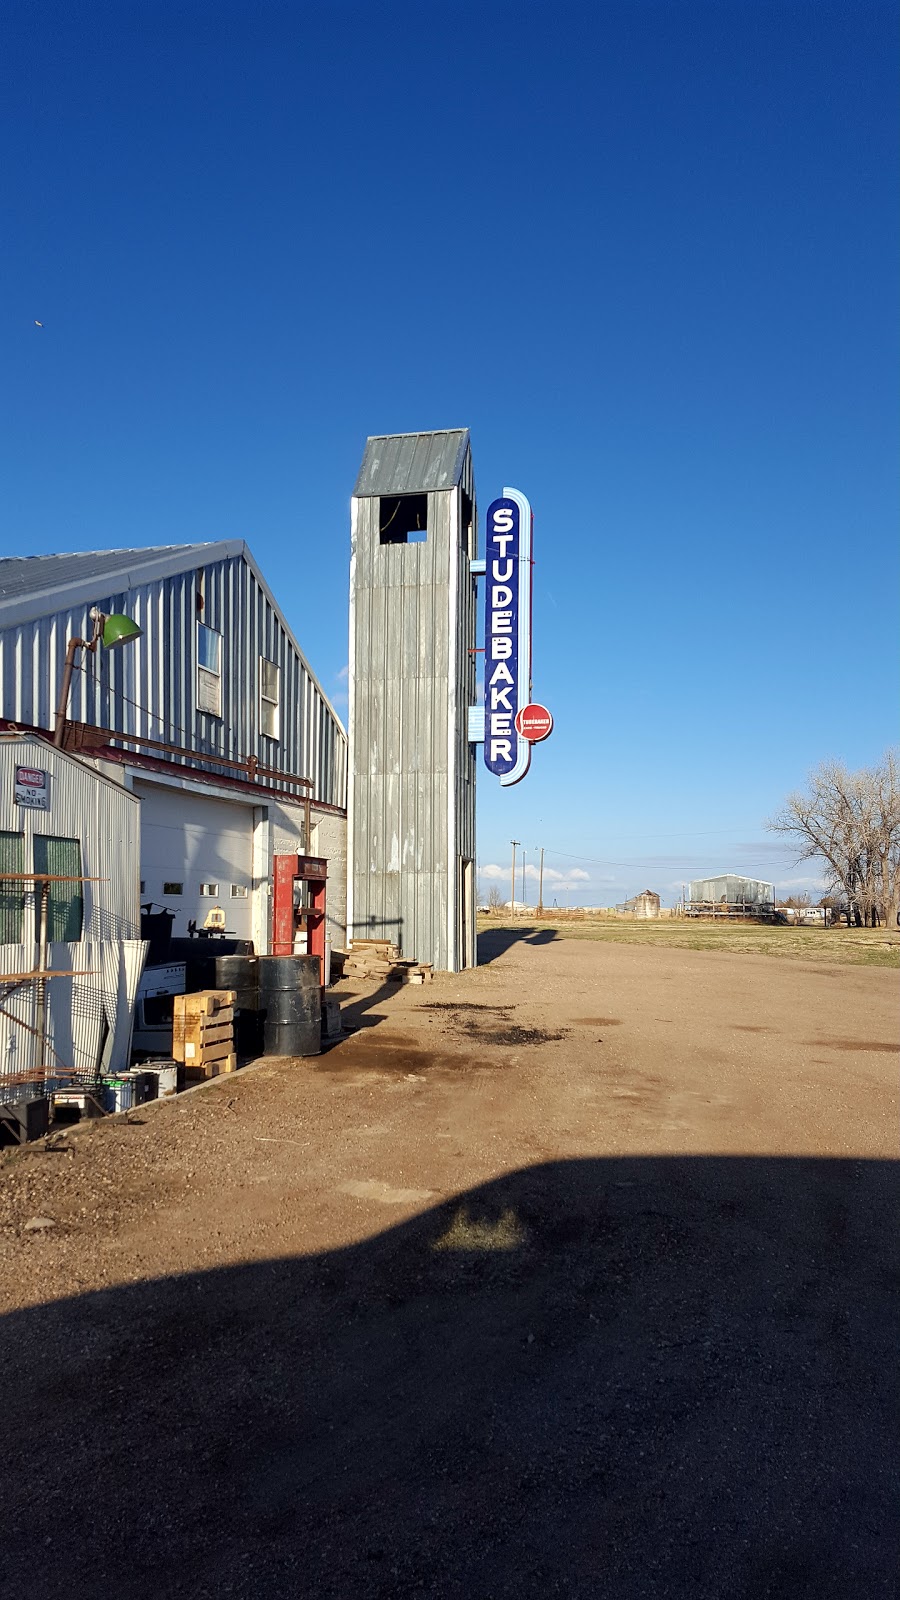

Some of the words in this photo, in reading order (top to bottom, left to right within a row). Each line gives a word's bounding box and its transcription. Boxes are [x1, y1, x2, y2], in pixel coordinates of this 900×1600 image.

[489, 508, 514, 762] STUDEBAKER
[19, 771, 43, 783] DANGER
[16, 793, 46, 805] SMOKING
